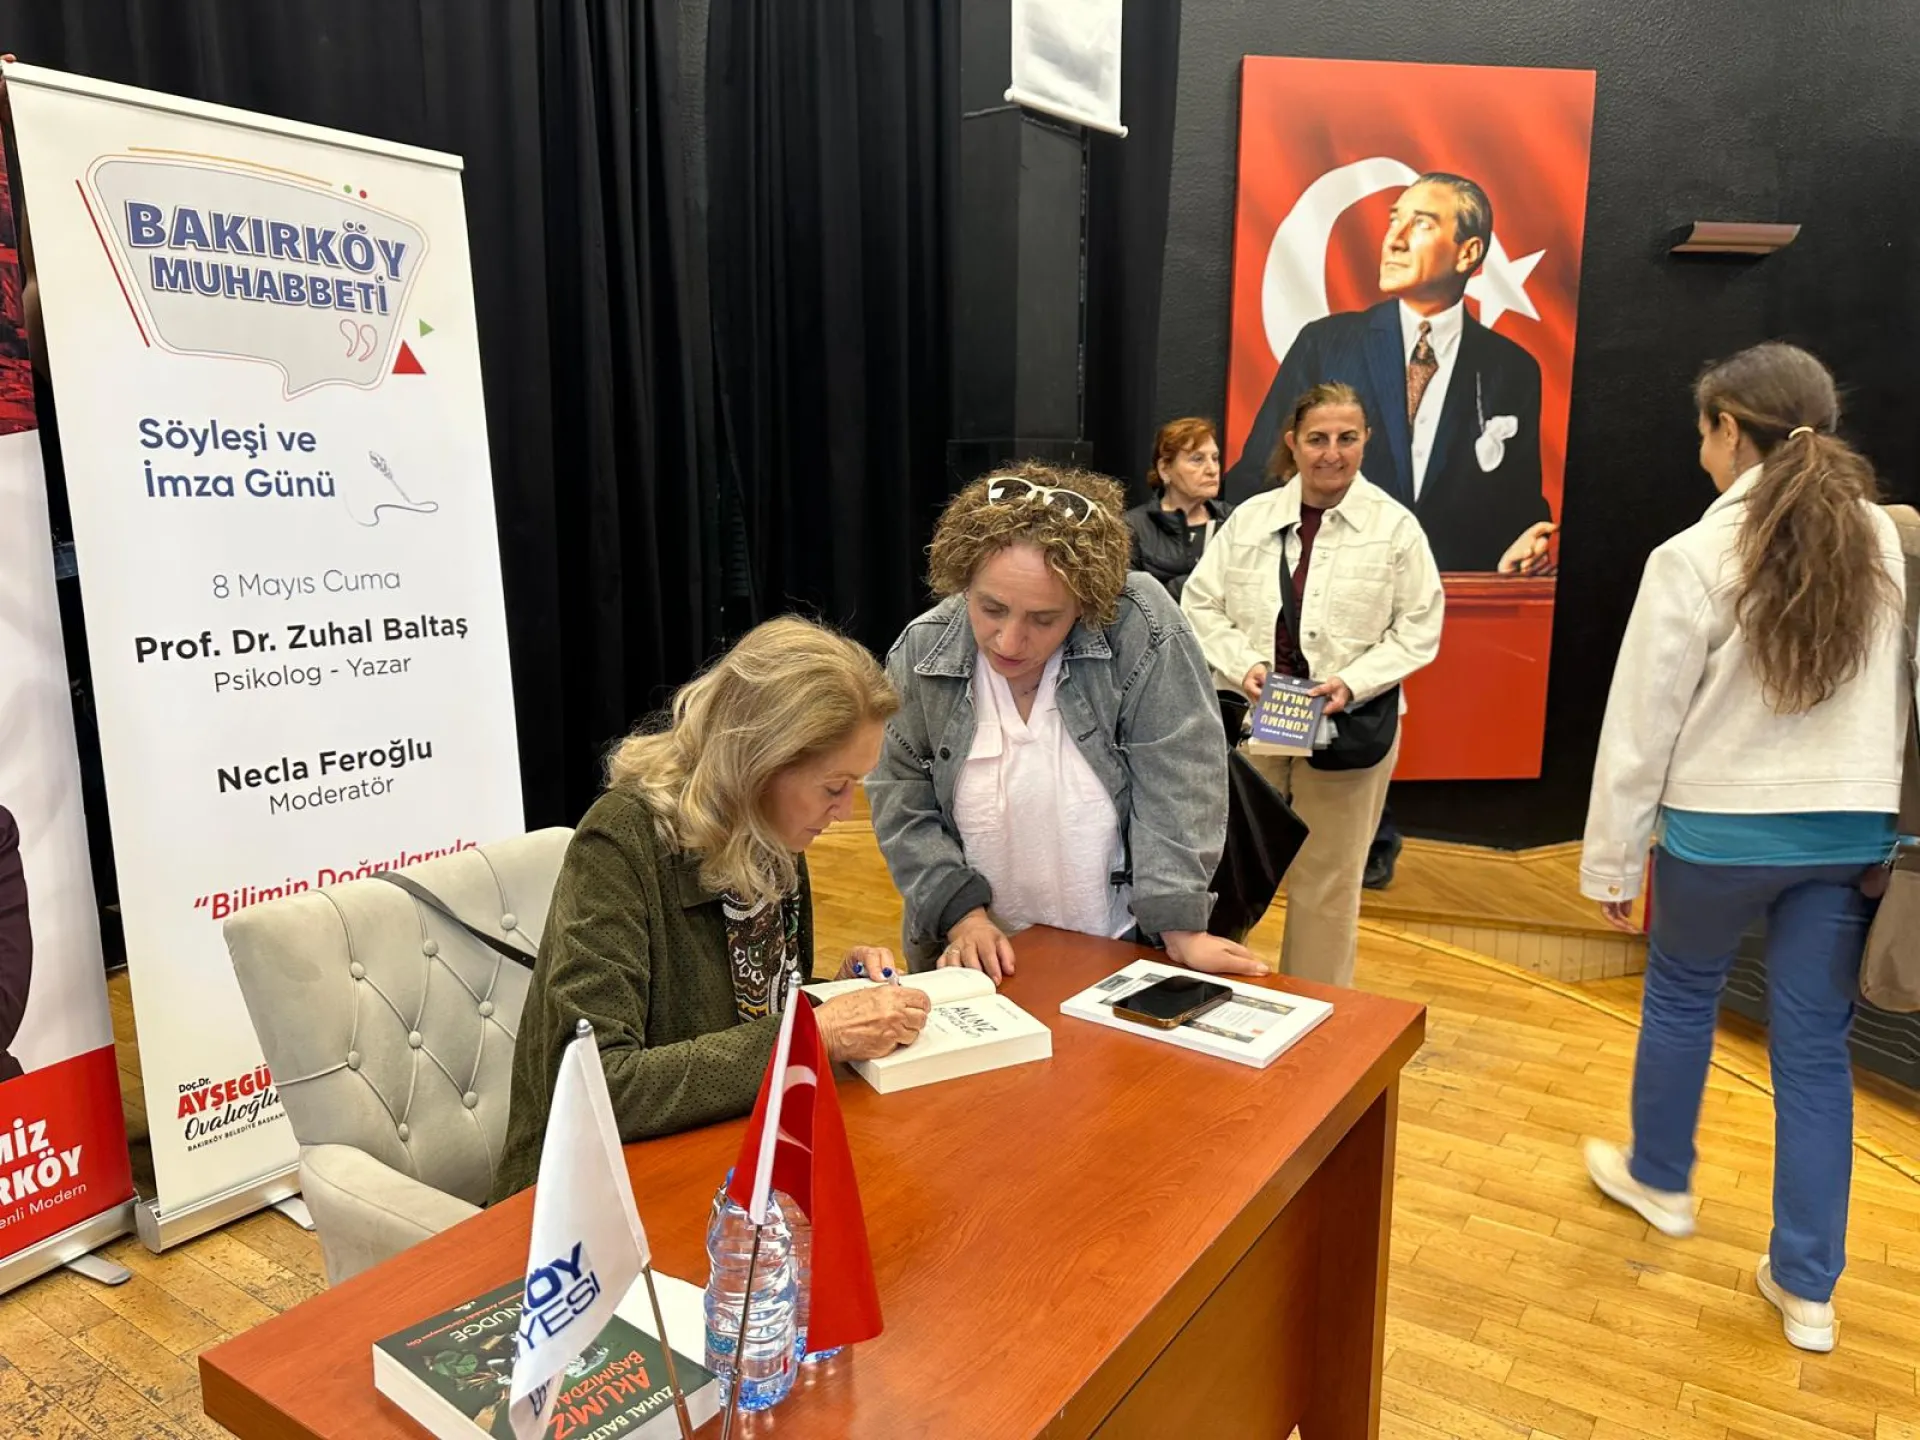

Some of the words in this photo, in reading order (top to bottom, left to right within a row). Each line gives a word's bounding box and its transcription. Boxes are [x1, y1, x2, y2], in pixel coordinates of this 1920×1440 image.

[126, 201, 406, 281] BAKIRKÖY
[151, 256, 389, 313] MUHABBETİ
[138, 418, 267, 458] Söyleşi
[277, 430, 317, 452] ve
[144, 460, 234, 498] İmza
[244, 469, 336, 498] Günü
[212, 574, 230, 599] 8
[238, 572, 316, 600] Mayıs
[323, 569, 401, 592] Cuma
[134, 630, 221, 663] Prof.
[233, 629, 276, 655] Dr.
[286, 619, 372, 650] Zuhal
[383, 614, 469, 641] Baltaş
[213, 663, 322, 693] Psikolog
[346, 656, 412, 679] Yazar
[1260, 714, 1311, 733] KURUMU
[217, 757, 309, 793] Necla
[319, 738, 433, 775] Feroğlu
[269, 775, 395, 815] Moderatör
[177, 1064, 272, 1119] AYŞEGÜ
[29, 1183, 88, 1216] Modern
[521, 1241, 583, 1317] ÖY
[449, 1302, 524, 1343] NUDGE
[624, 1385, 684, 1418] ZUHAL
